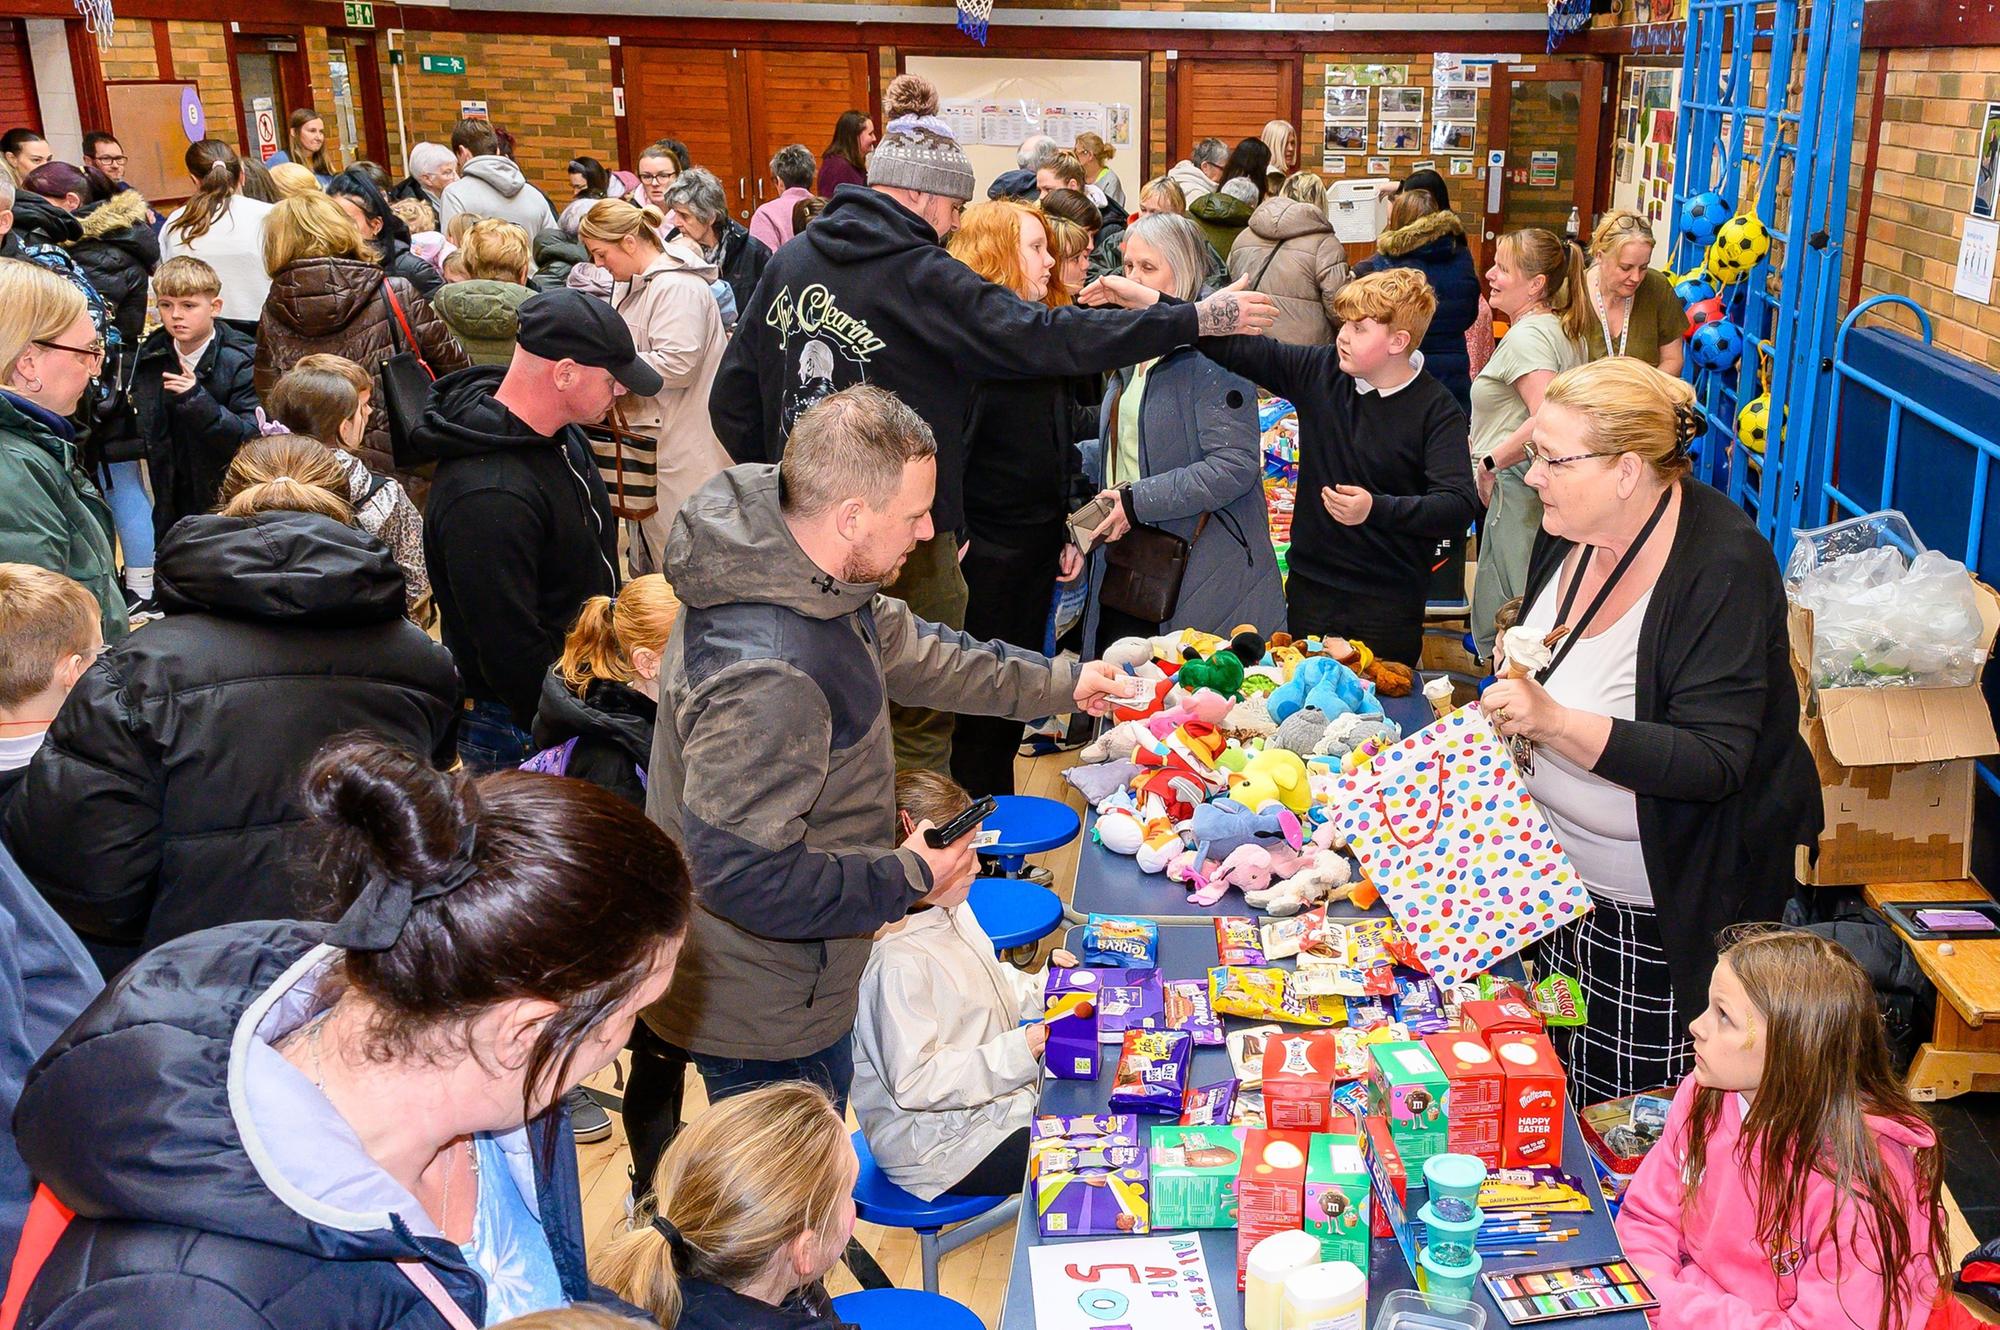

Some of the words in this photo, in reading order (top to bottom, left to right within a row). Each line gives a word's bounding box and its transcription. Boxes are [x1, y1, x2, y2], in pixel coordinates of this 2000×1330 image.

[766, 285, 794, 350] The
[797, 283, 887, 363] Clearing
[1552, 979, 1578, 1019] HARIBO
[1412, 1100, 1423, 1109] m
[1518, 1117, 1551, 1125] HAPPY
[1518, 1125, 1551, 1133] EASTER
[1327, 1201, 1340, 1212] m
[1064, 1263, 1142, 1330] 50
